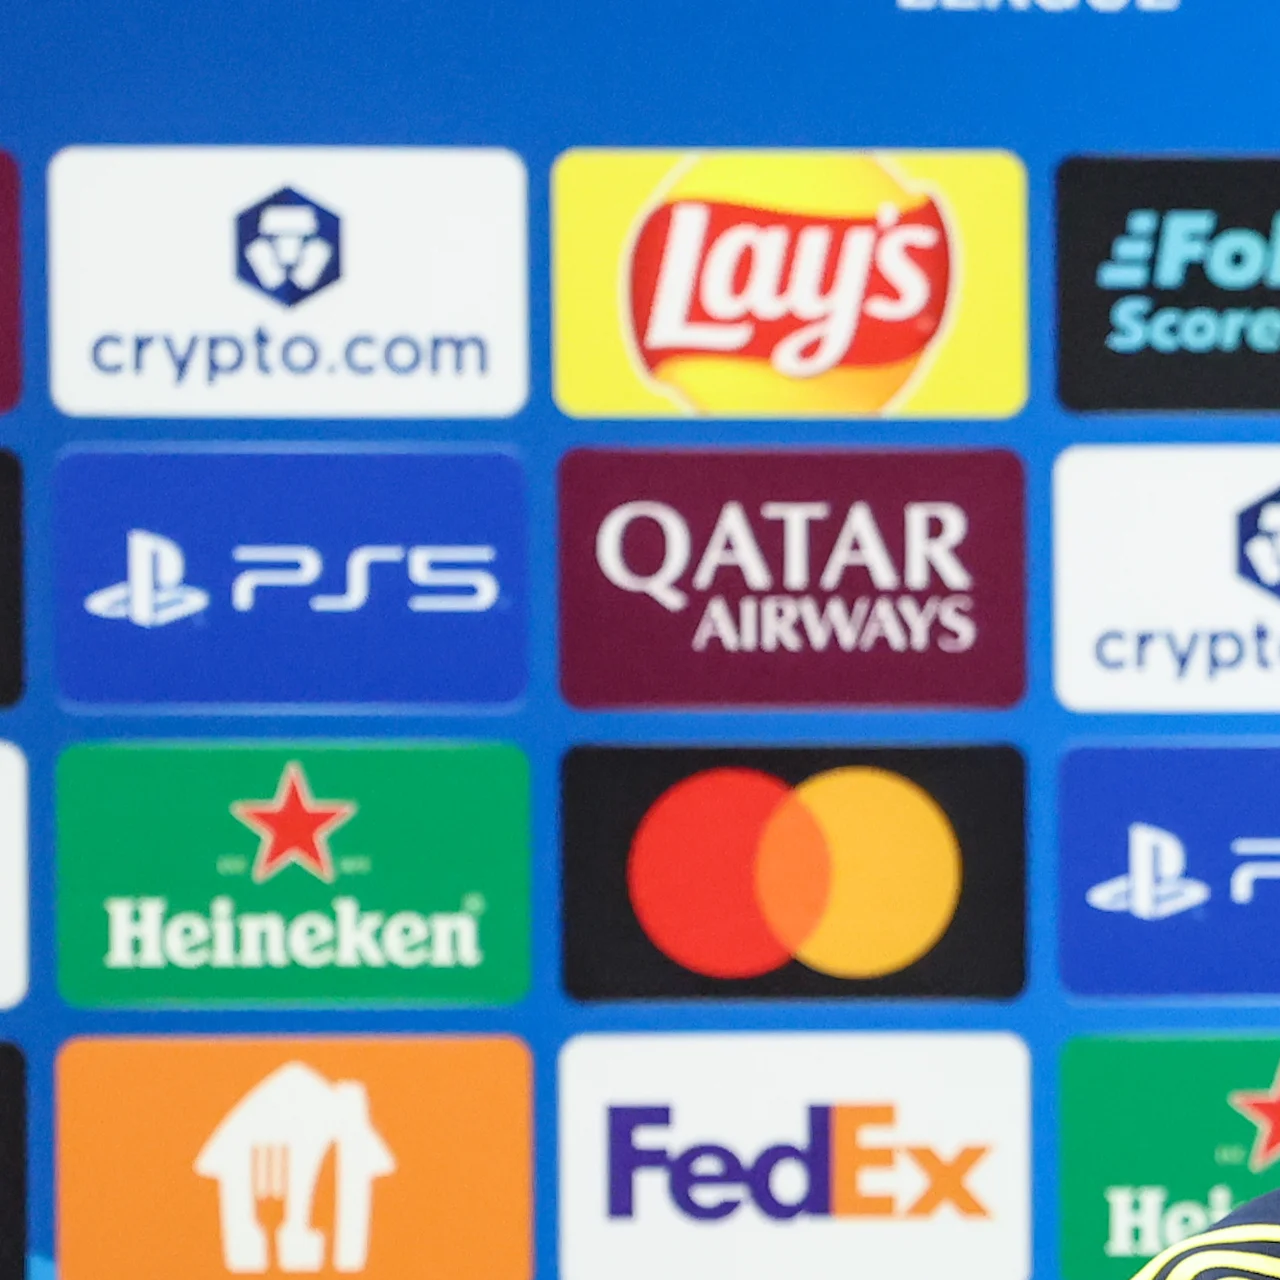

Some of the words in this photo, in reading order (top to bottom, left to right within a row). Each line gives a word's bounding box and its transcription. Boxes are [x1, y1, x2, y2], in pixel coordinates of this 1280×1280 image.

[643, 200, 941, 379] Lay's
[90, 324, 489, 387] crypto.com
[231, 545, 499, 612] PS5
[596, 500, 973, 612] QATAR
[692, 594, 978, 652] AIRWAYS
[104, 896, 483, 969] Heineken
[604, 1102, 991, 1224] FedEx
